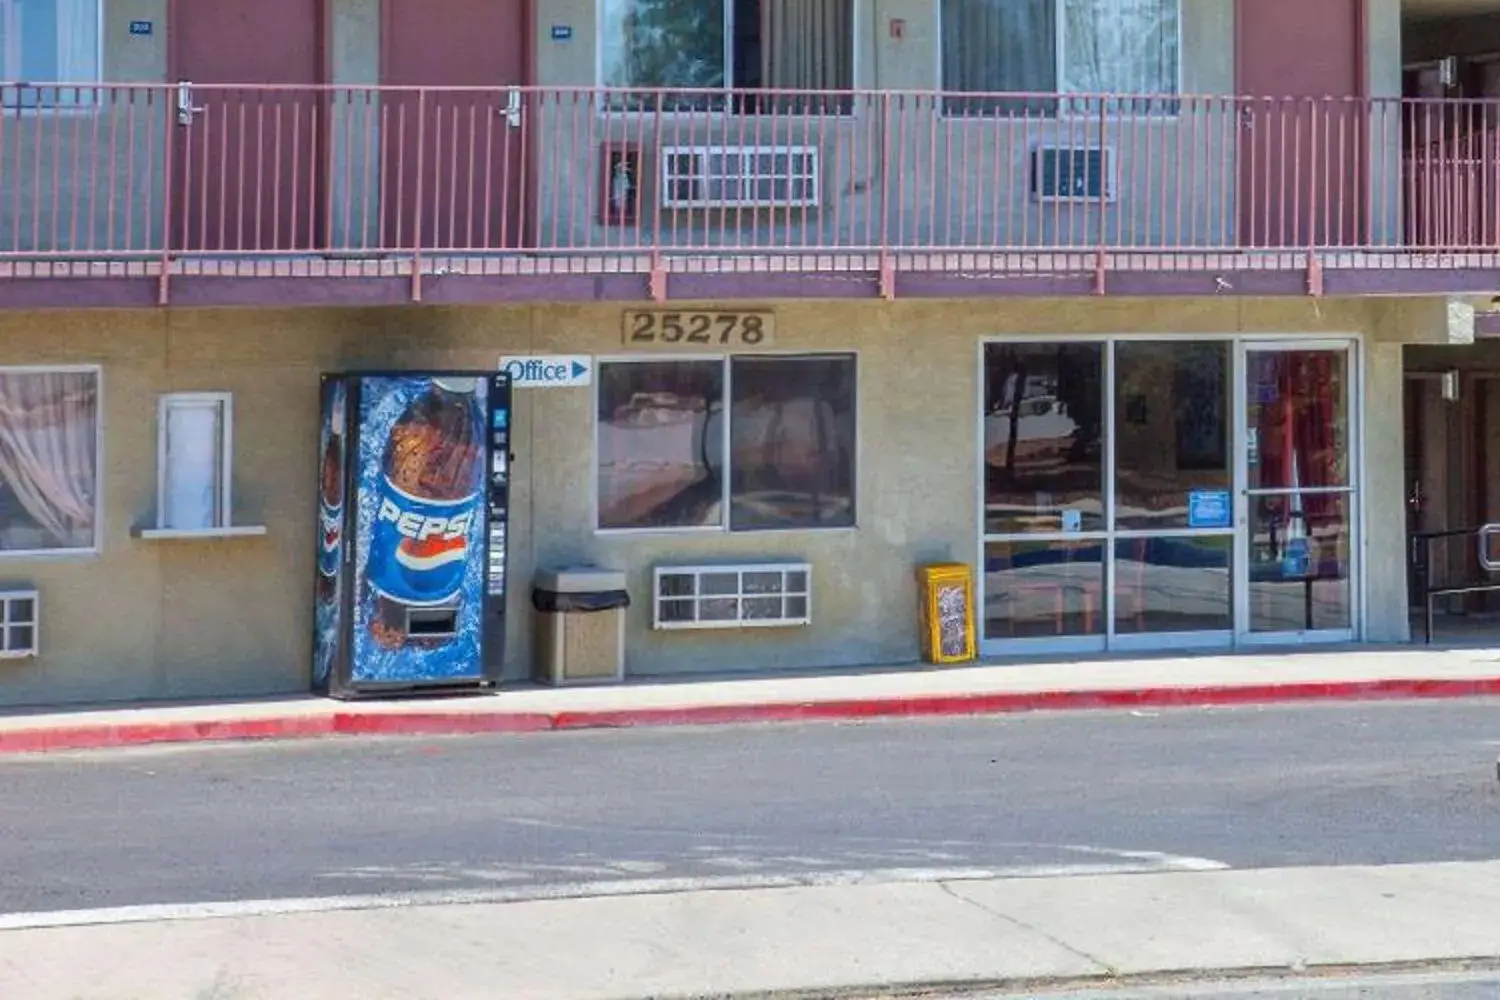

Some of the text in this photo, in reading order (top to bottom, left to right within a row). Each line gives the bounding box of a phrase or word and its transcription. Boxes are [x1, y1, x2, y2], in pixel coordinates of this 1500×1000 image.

[631, 313, 764, 345] 25278
[505, 359, 567, 381] Office
[378, 497, 474, 541] PEPSI
